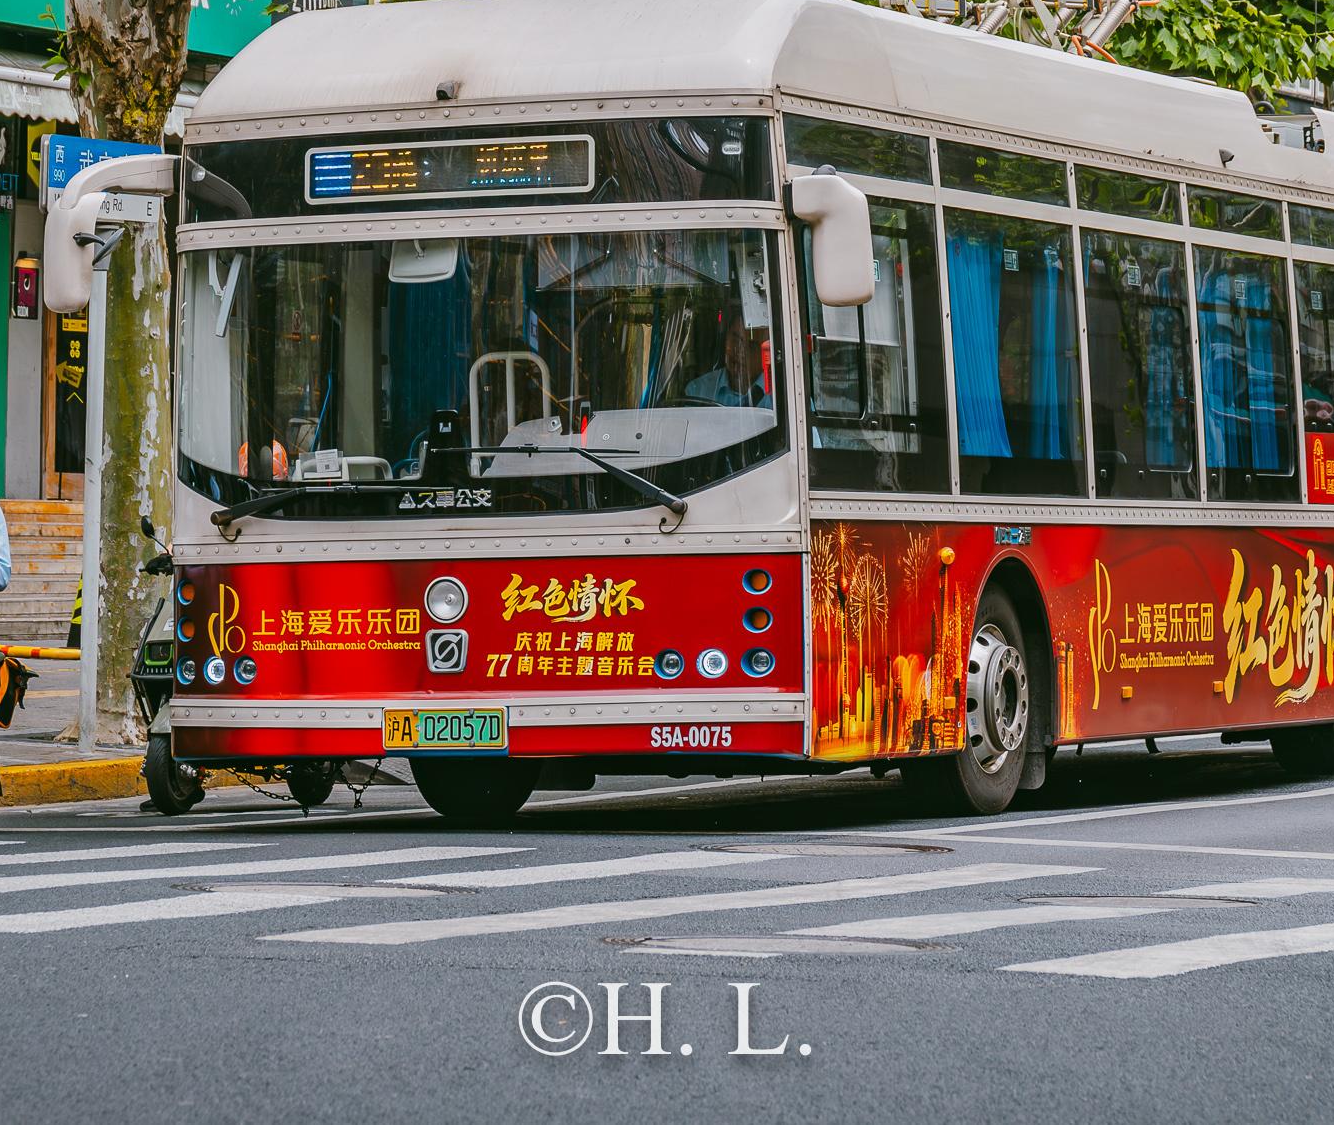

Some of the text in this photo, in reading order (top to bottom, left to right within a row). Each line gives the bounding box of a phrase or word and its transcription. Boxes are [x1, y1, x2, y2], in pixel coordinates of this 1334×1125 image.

[55, 144, 65, 163] 西
[53, 168, 65, 182] 990
[112, 198, 124, 211] Rd.
[147, 201, 152, 216] E
[501, 573, 645, 623] 红色情怀
[252, 608, 420, 636] 上海爱乐乐团
[1120, 602, 1214, 644] 上海爱乐乐团
[252, 639, 420, 654] Shanghai Philharmonic Orchestra
[514, 632, 635, 652] 庆祝上海解放
[1120, 651, 1214, 673] Shanghai Philharmonic Orchestra
[650, 726, 732, 747] S5A-0075
